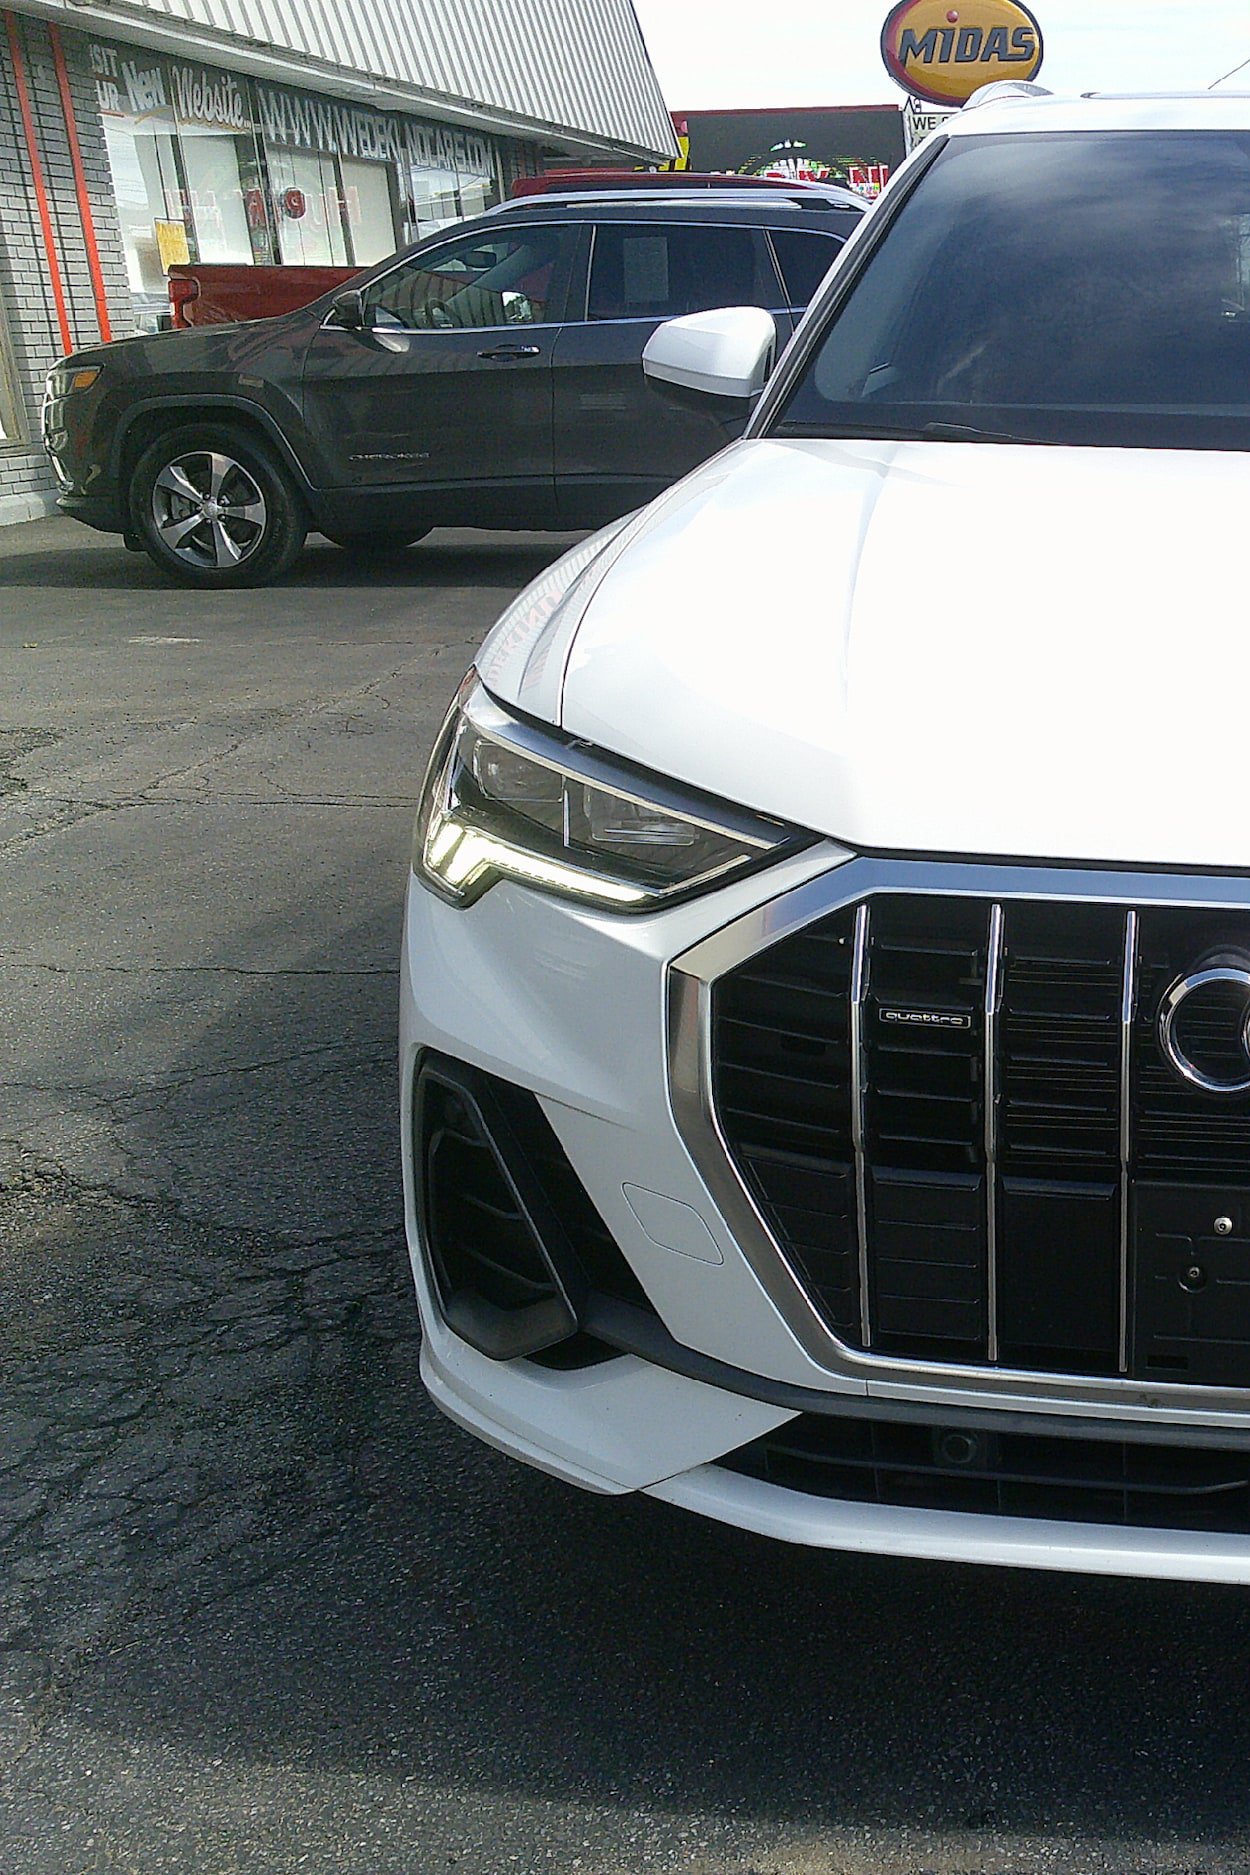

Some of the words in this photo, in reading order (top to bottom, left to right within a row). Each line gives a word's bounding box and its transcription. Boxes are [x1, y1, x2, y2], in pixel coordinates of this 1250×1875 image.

[899, 26, 1036, 66] MIDAS
[912, 116, 936, 130] WE
[885, 1012, 964, 1025] quattro
